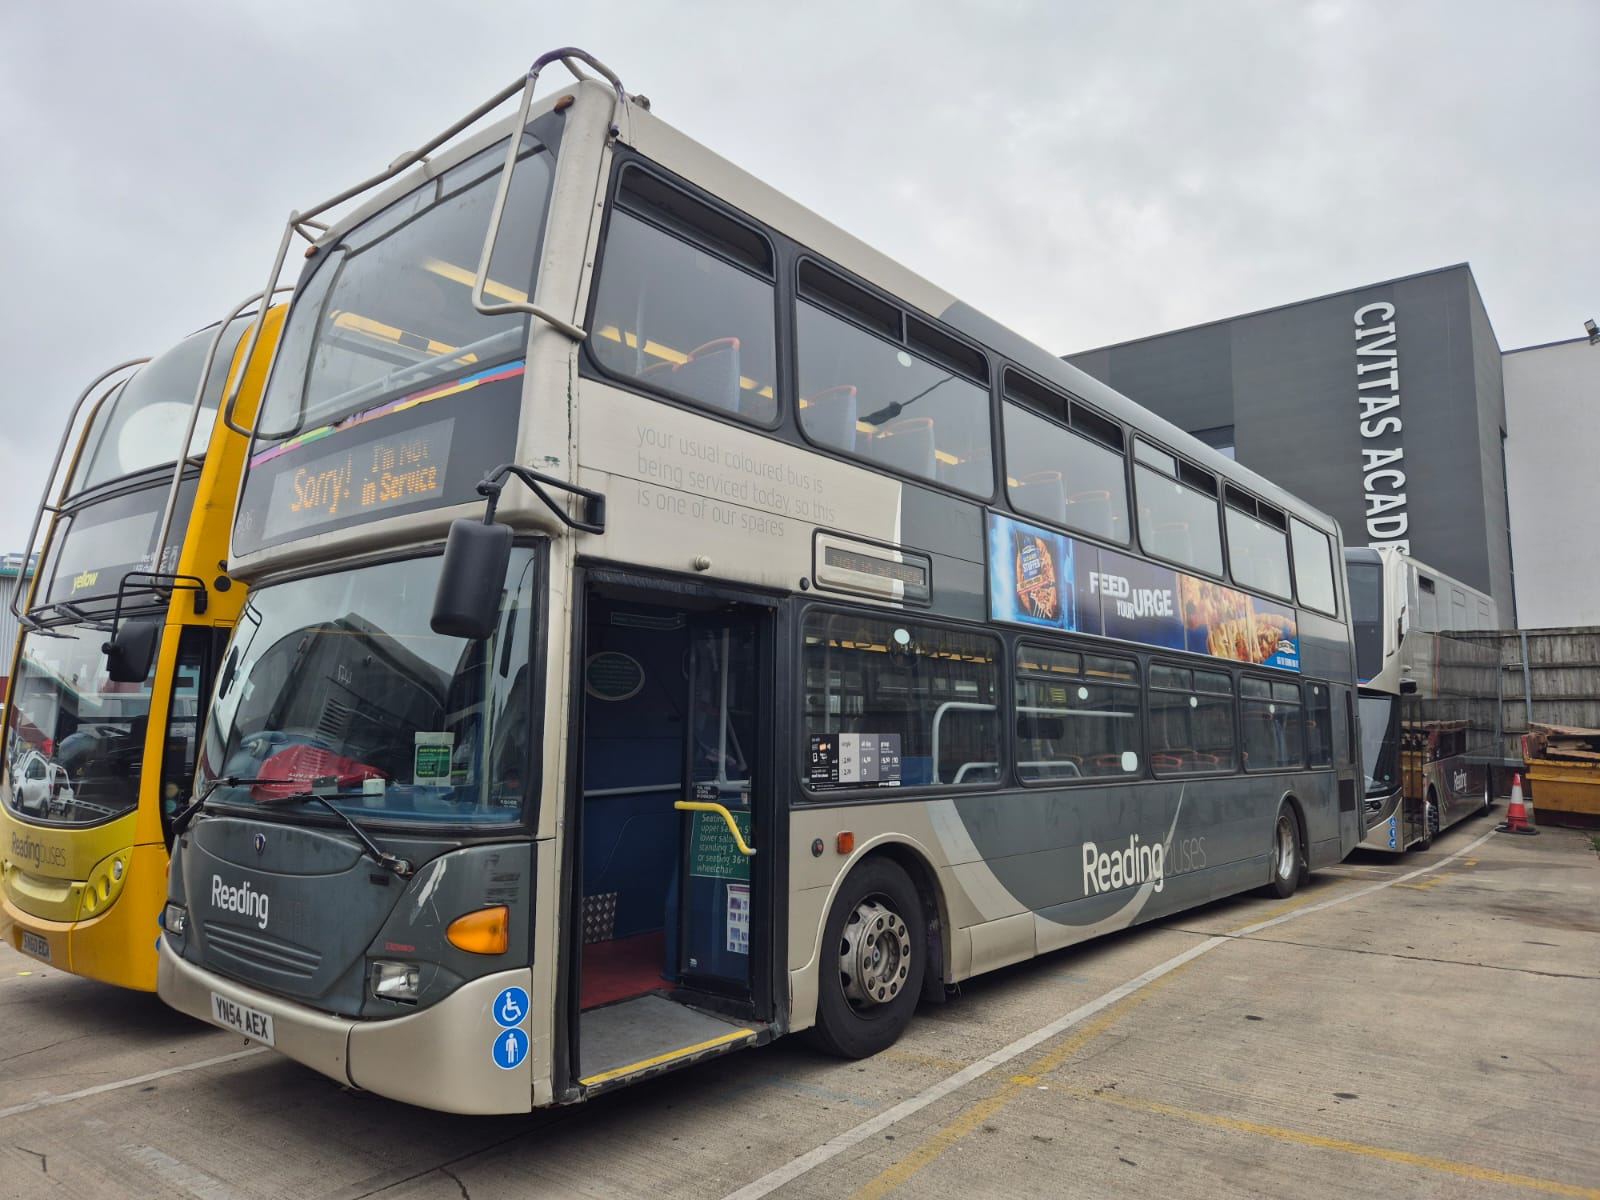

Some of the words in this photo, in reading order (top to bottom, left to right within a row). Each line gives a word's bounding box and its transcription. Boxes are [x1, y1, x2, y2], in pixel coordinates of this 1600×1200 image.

[1353, 301, 1403, 439] CIVITAS
[637, 424, 674, 449] your
[679, 436, 720, 463] usual
[724, 450, 783, 482] coloured
[787, 463, 810, 490] bus
[813, 478, 824, 494] is
[291, 454, 352, 513] Sorry!
[361, 477, 378, 506] in
[379, 465, 438, 502] Service
[637, 454, 684, 486] being
[689, 470, 748, 501] serviced
[795, 498, 809, 516] so
[813, 497, 835, 522] this
[637, 487, 650, 507] is
[656, 494, 686, 515] one
[692, 499, 707, 520] of
[712, 506, 736, 528] our
[741, 514, 785, 538] spares
[71, 570, 99, 595] yellow
[1089, 571, 1130, 598] FEED
[1116, 600, 1135, 620] YOUR
[1132, 589, 1174, 617] URGE
[701, 825, 720, 833] upper
[702, 815, 726, 825] Seating
[699, 834, 717, 842] lower
[699, 844, 727, 855] standing
[696, 863, 734, 875] wheelchair
[706, 855, 730, 865] seating
[211, 874, 269, 930] Reading
[216, 997, 243, 1029] YN54
[245, 1009, 269, 1040] AEX
